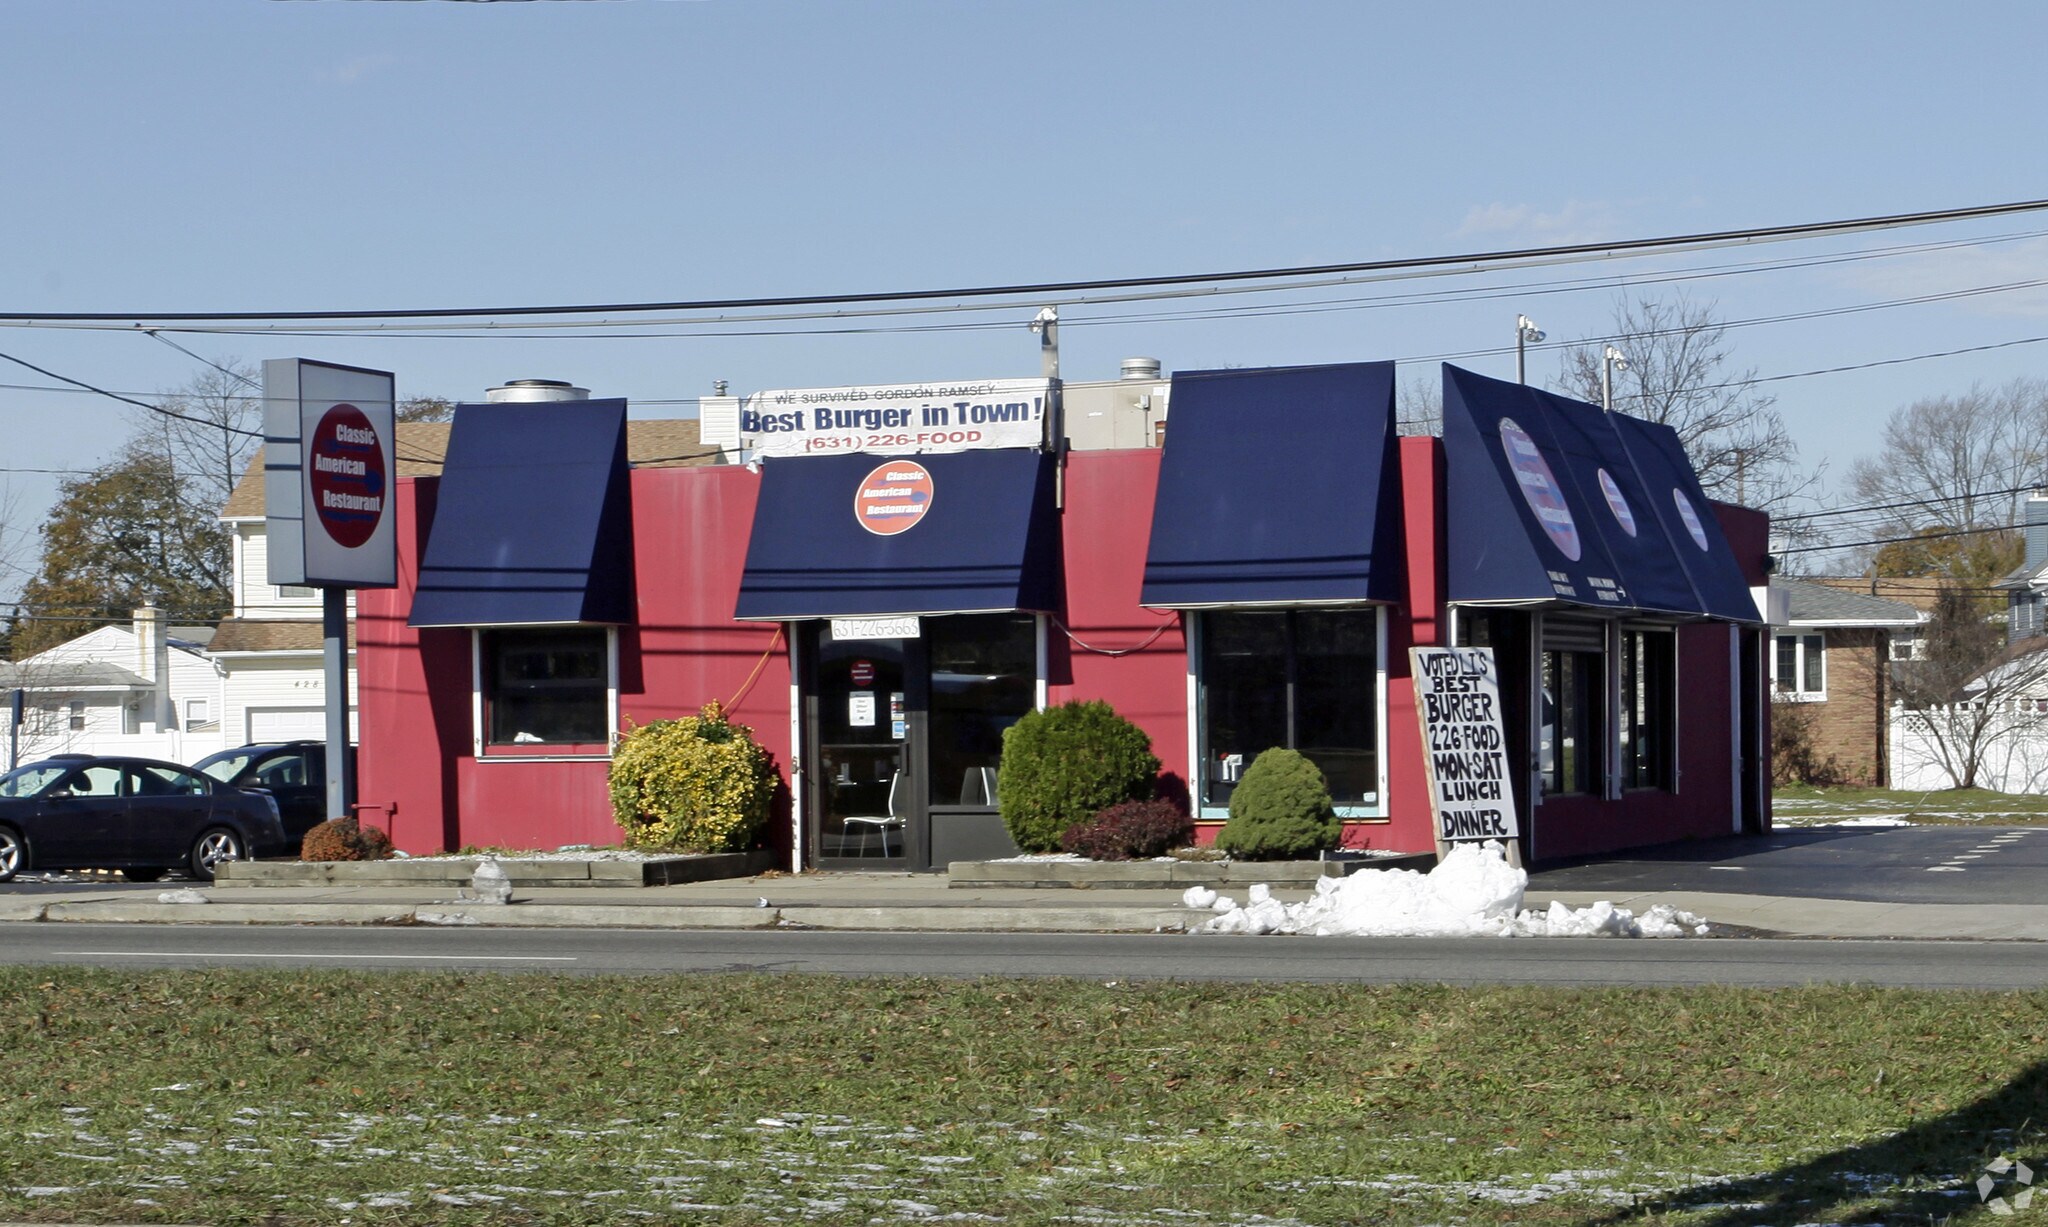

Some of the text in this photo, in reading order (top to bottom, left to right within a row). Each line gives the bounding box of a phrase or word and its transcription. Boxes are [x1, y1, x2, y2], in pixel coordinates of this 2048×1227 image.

[776, 394, 797, 404] WE
[801, 391, 868, 404] SURVIVED
[874, 388, 933, 400] GORDON
[742, 397, 1043, 433] Best Burger in Town!
[336, 423, 375, 446] Classic
[805, 430, 982, 453] (631) 226-FOOD
[315, 453, 366, 476] American
[886, 471, 925, 482] Classic
[323, 489, 381, 512] Restaurant
[862, 487, 913, 499] American
[866, 504, 924, 516] Restaurant
[1418, 653, 1459, 677] VOTED
[1431, 676, 1481, 693] BEST
[1424, 693, 1495, 723] BURGER
[1429, 724, 1500, 750] 226-FOOD
[1433, 752, 1503, 780] MON-SAT
[1441, 781, 1502, 802] LUNCH
[1440, 809, 1508, 838] DINNER
